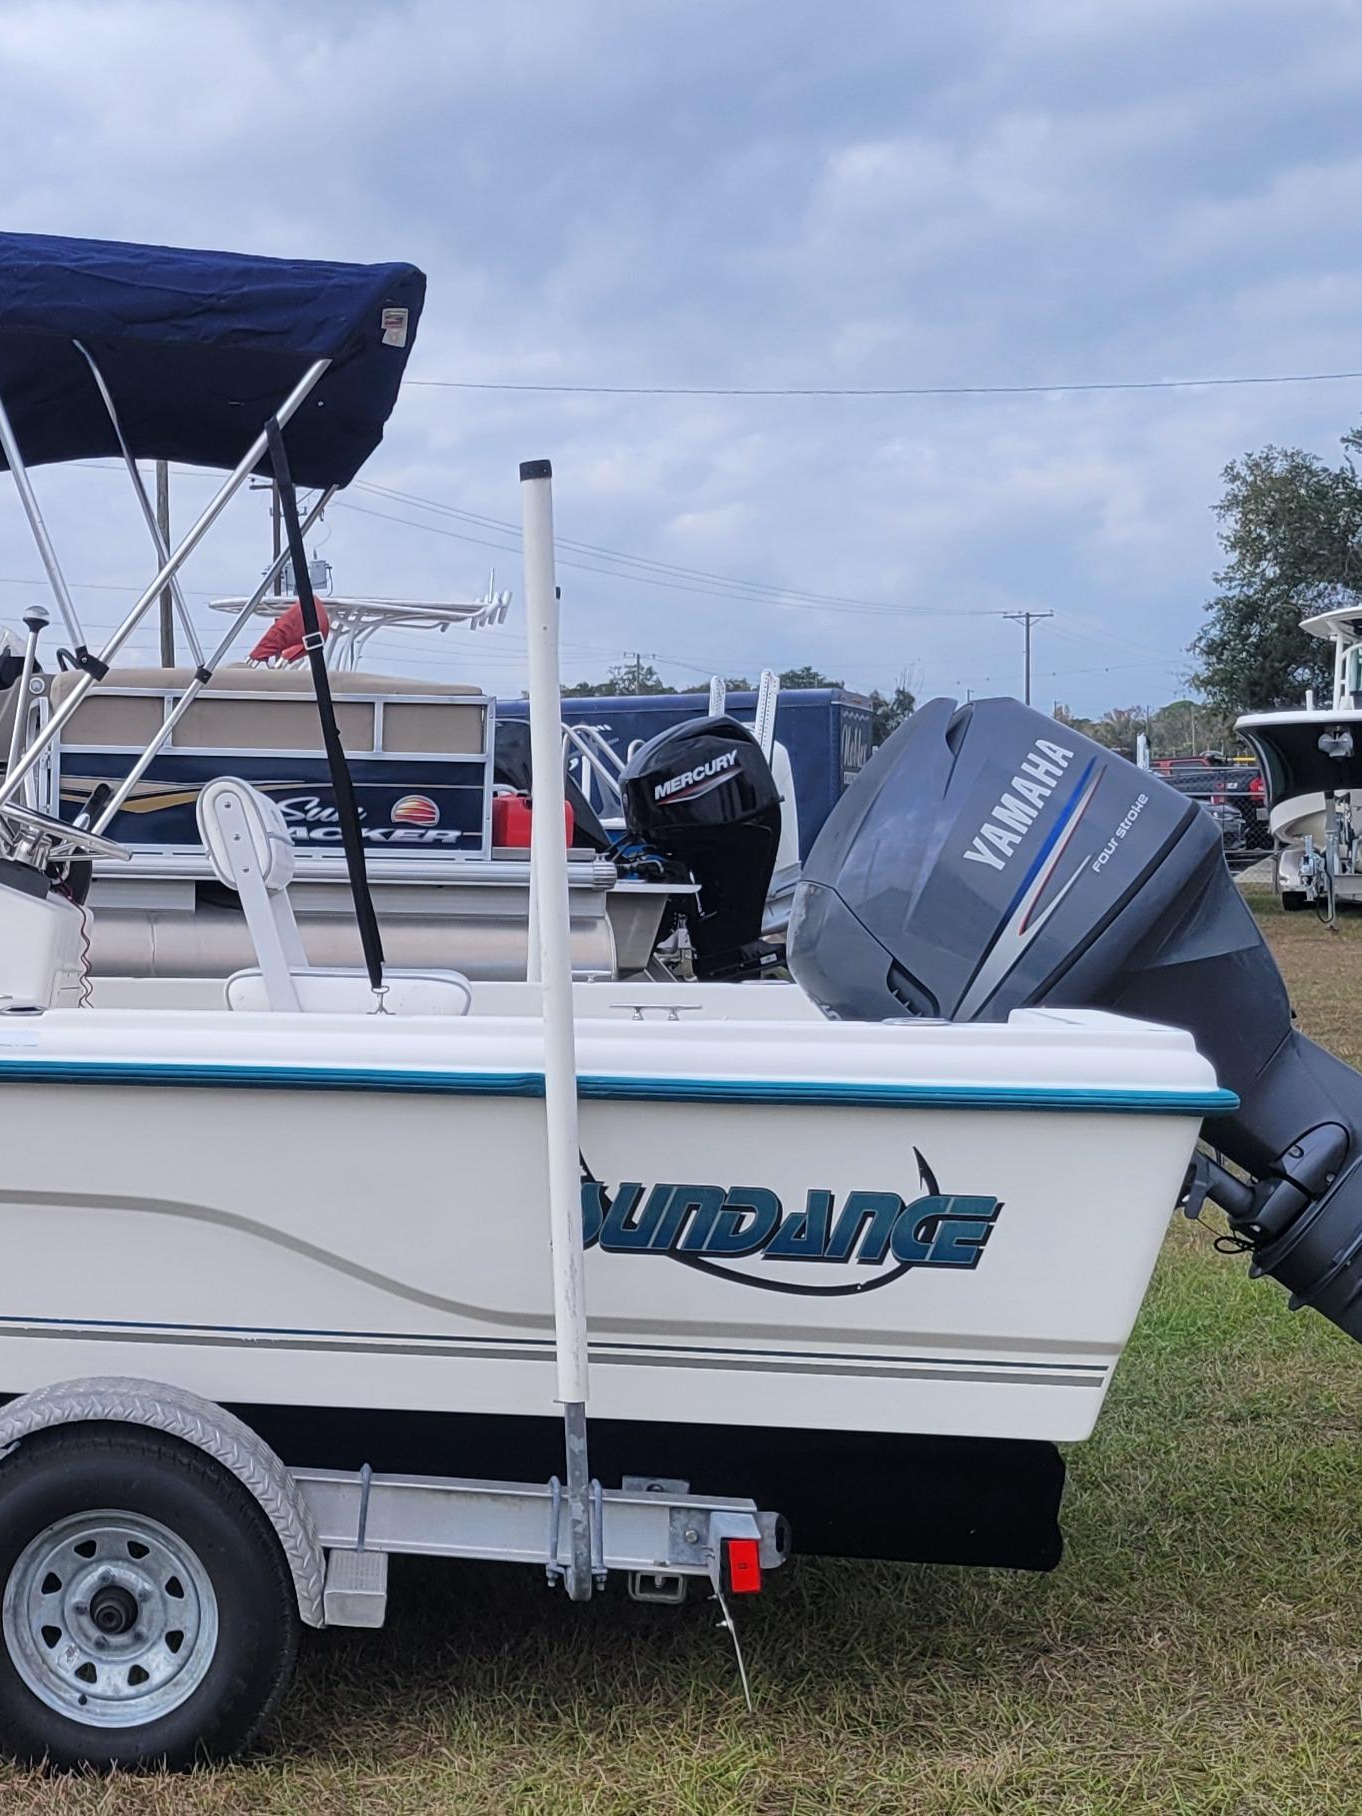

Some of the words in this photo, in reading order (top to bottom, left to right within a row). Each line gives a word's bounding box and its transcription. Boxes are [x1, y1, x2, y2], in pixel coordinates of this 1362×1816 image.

[653, 749, 738, 801] MERCURY
[963, 738, 1075, 872] YAMAHA
[289, 826, 463, 844] ACKER
